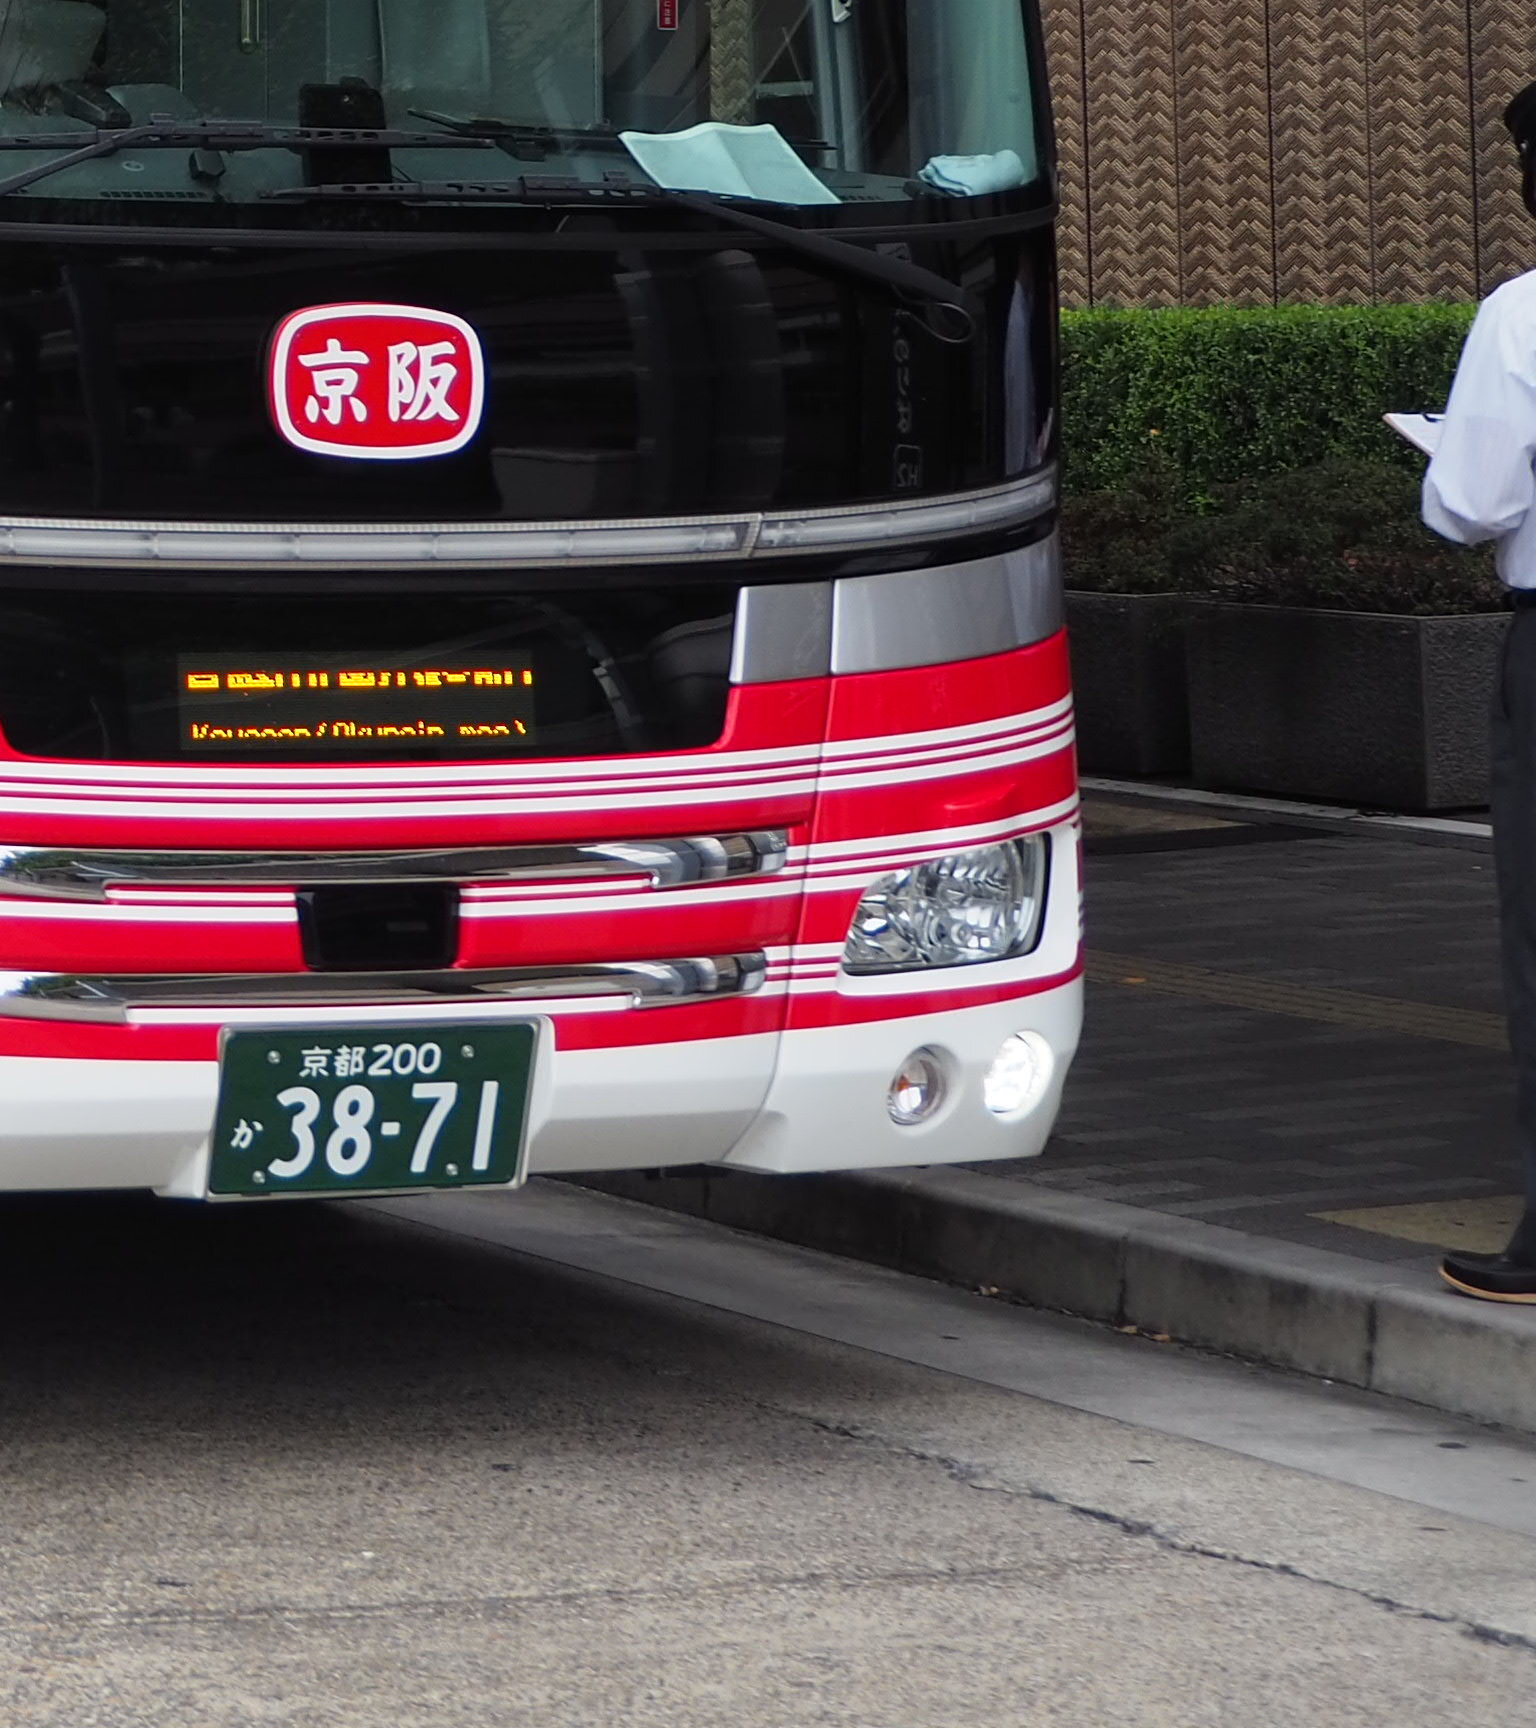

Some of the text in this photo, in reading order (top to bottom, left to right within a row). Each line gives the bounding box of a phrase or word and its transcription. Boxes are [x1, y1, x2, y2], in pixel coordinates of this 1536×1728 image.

[298, 338, 460, 425] 京阪
[230, 1081, 499, 1178] か 38-71
